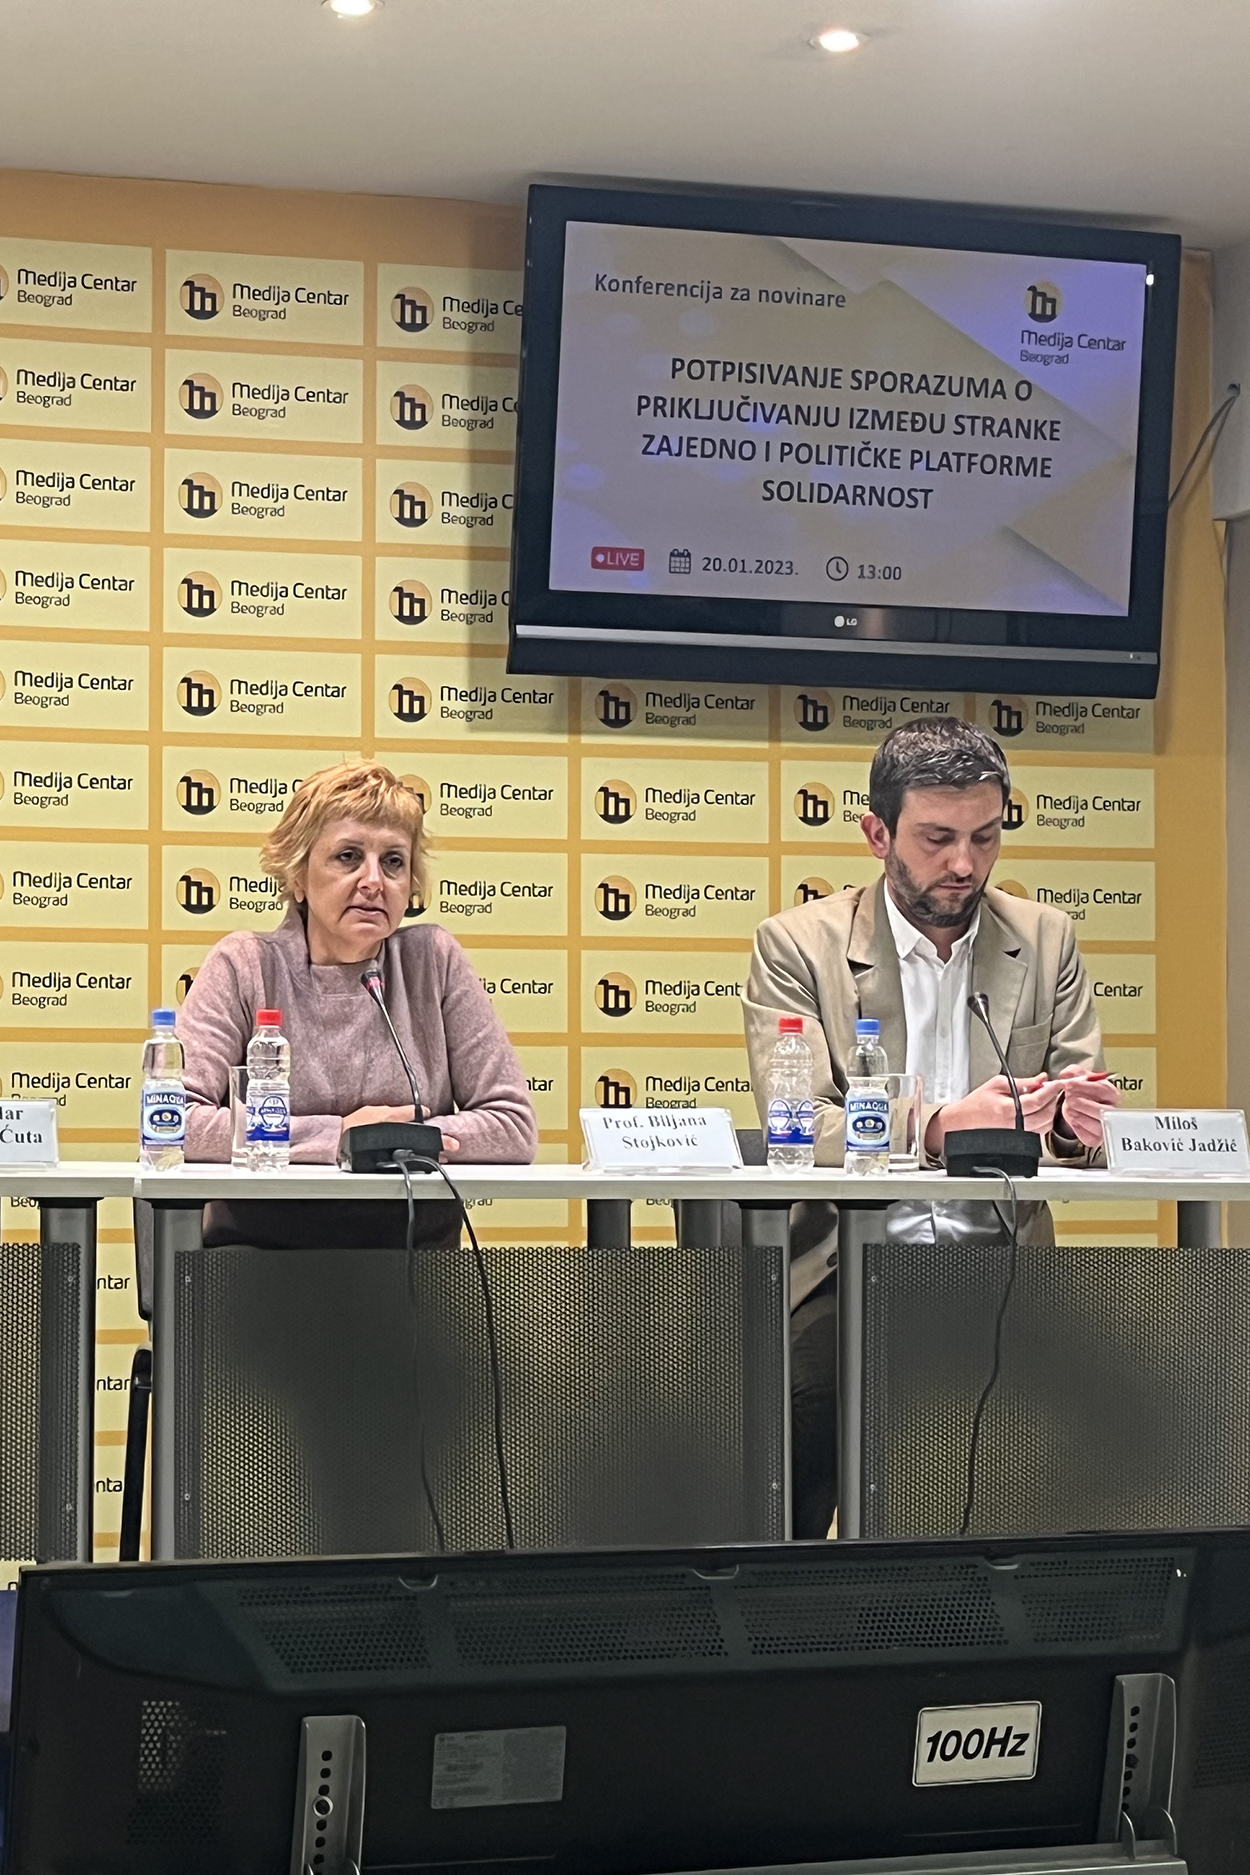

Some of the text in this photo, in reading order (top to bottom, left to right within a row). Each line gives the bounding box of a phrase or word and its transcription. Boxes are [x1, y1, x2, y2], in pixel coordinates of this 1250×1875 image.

[18, 269, 137, 292] Medija Centar
[18, 290, 72, 307] Beograd
[233, 283, 349, 305] Medija Centar
[594, 273, 847, 308] Konferencija za novinare
[233, 305, 286, 321] Beograd
[443, 297, 498, 318] Medija
[443, 317, 494, 334] Beograd
[1020, 329, 1127, 351] Medija Centar
[1019, 349, 1069, 366] Beograd
[671, 357, 1033, 401] POTPISIVANJE SPORAZUMA O
[636, 394, 1061, 441] PRIKLJUČIVANJU IZMEĐU STRANKE
[641, 433, 1052, 478] ZAJEDNO I POLITIČKE PLATFORME
[232, 481, 348, 503] Medija Centar
[442, 490, 498, 512] Medija
[761, 479, 934, 509] SOLIDARNOST
[232, 503, 284, 519] Beograd
[442, 512, 493, 528] Beograd
[606, 551, 640, 568] LIVE
[701, 556, 799, 576] 20.01.2023.
[857, 563, 903, 581] 13:00
[15, 671, 134, 692] Medija Centar
[15, 692, 69, 708] Beograd
[441, 686, 554, 706] Medija Centar
[646, 692, 755, 712] Medija Centar
[843, 695, 950, 715] Medija Centar
[441, 706, 493, 722] Beograd
[646, 712, 696, 728] Beograd
[1036, 701, 1140, 721] Medija Centar
[1036, 721, 1084, 736] Beograd
[14, 771, 133, 792] Medija Centar
[230, 778, 287, 798] Medija
[14, 792, 68, 808] Beograd
[440, 783, 554, 803] Medija Centar
[646, 788, 755, 807] Medija Centar
[440, 803, 492, 819] Beograd
[1037, 794, 1141, 814] Medija Centar
[646, 808, 696, 823] Beograd
[1037, 814, 1084, 829] Beograd
[13, 871, 132, 892] Medija Centar
[440, 880, 553, 900] Medija Centar
[13, 893, 67, 908] Beograd
[646, 884, 756, 904] Medija Centar
[1037, 888, 1142, 907] Medija Centar
[440, 901, 492, 916] Beograd
[645, 904, 696, 919] Beograd
[12, 972, 132, 992] Medija Centar
[500, 979, 553, 994] Centar
[646, 980, 700, 999] Medija
[1094, 982, 1143, 997] Centar
[12, 993, 67, 1009] Beograd
[646, 1000, 696, 1016] Beograd
[12, 1072, 131, 1093] Medija Centar
[646, 1076, 700, 1095] Medija
[602, 1114, 707, 1130] Prof. Biljana
[1154, 1116, 1198, 1131] Miloš
[621, 1134, 699, 1151] Stojković
[1188, 1138, 1238, 1153] Jadžić
[926, 1725, 1030, 1763] 100Hz
